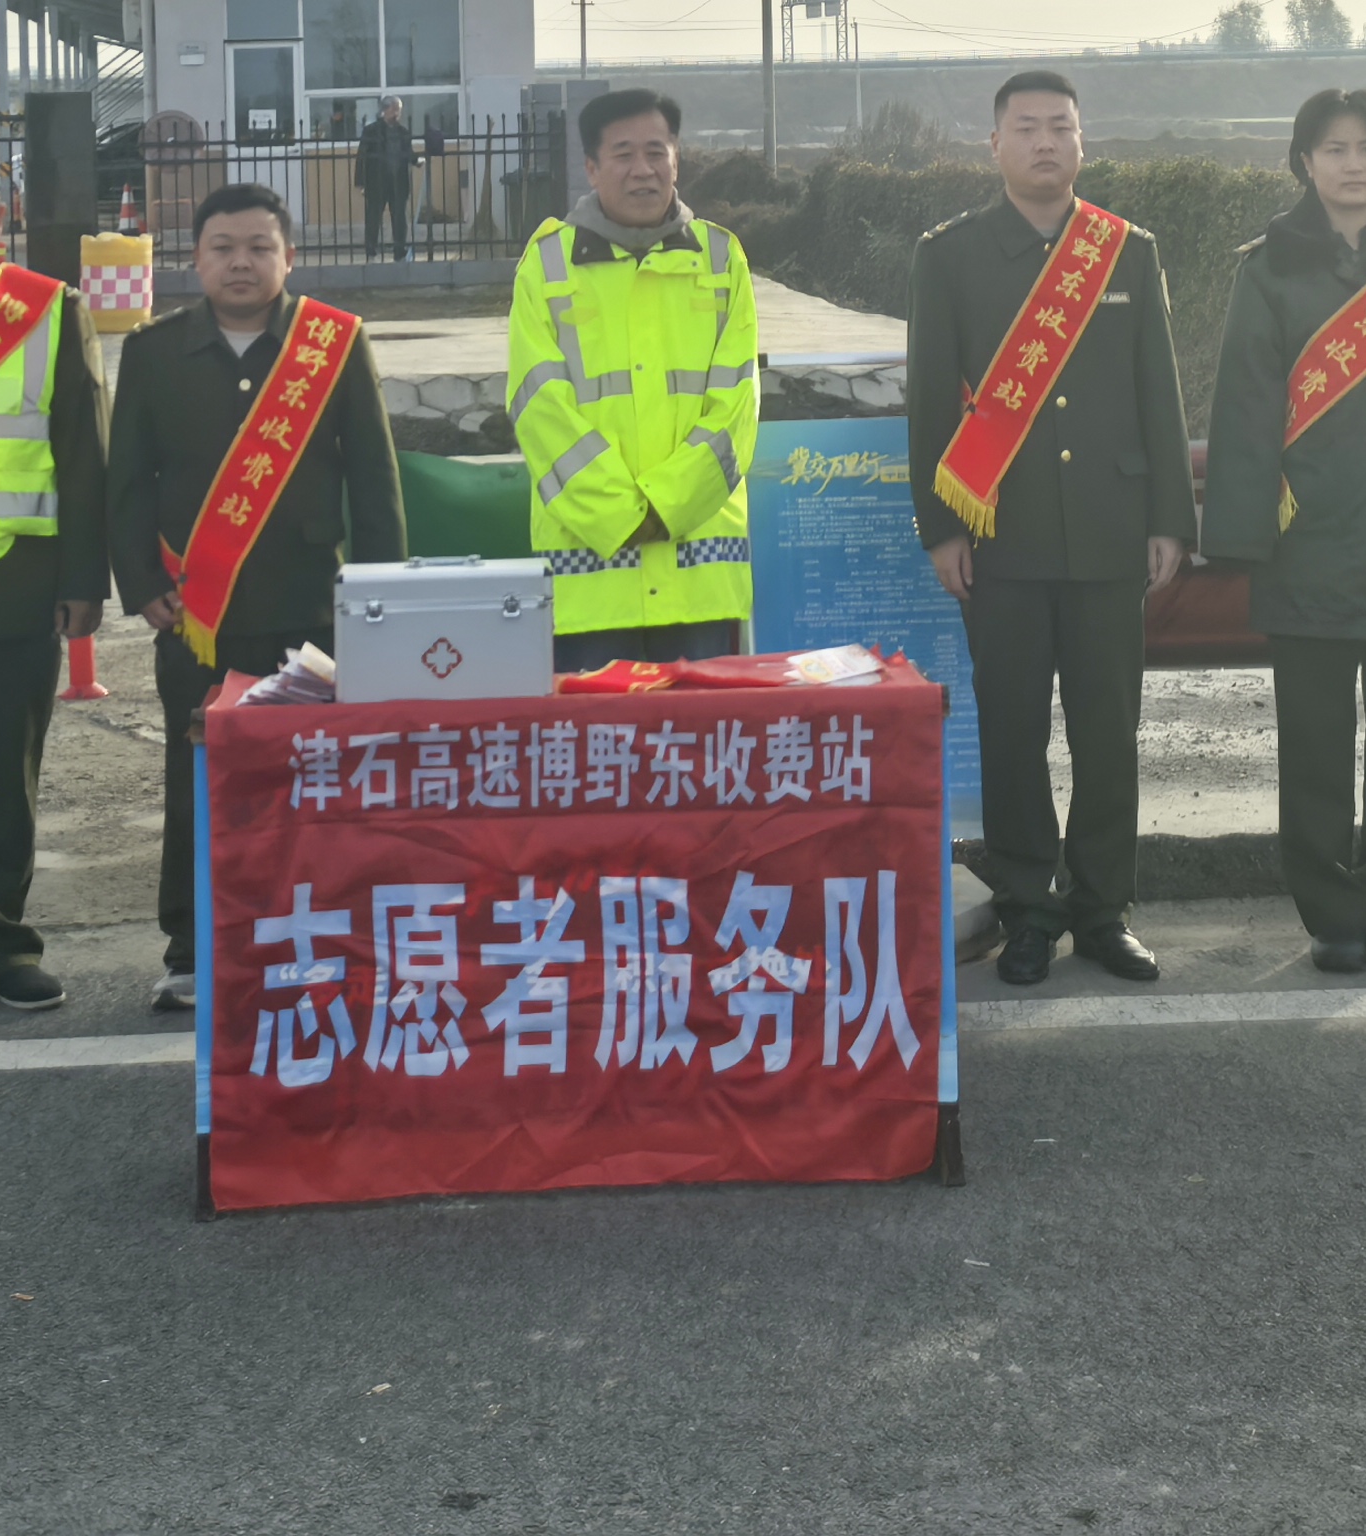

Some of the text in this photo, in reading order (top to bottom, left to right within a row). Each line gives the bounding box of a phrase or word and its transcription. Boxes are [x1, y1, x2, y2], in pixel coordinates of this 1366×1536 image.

[991, 211, 1118, 412] 博野东收费站
[217, 315, 344, 527] 博野东收费站
[289, 713, 875, 811] 津石高速博野东收费站
[249, 869, 922, 1088] 志愿者服务队
